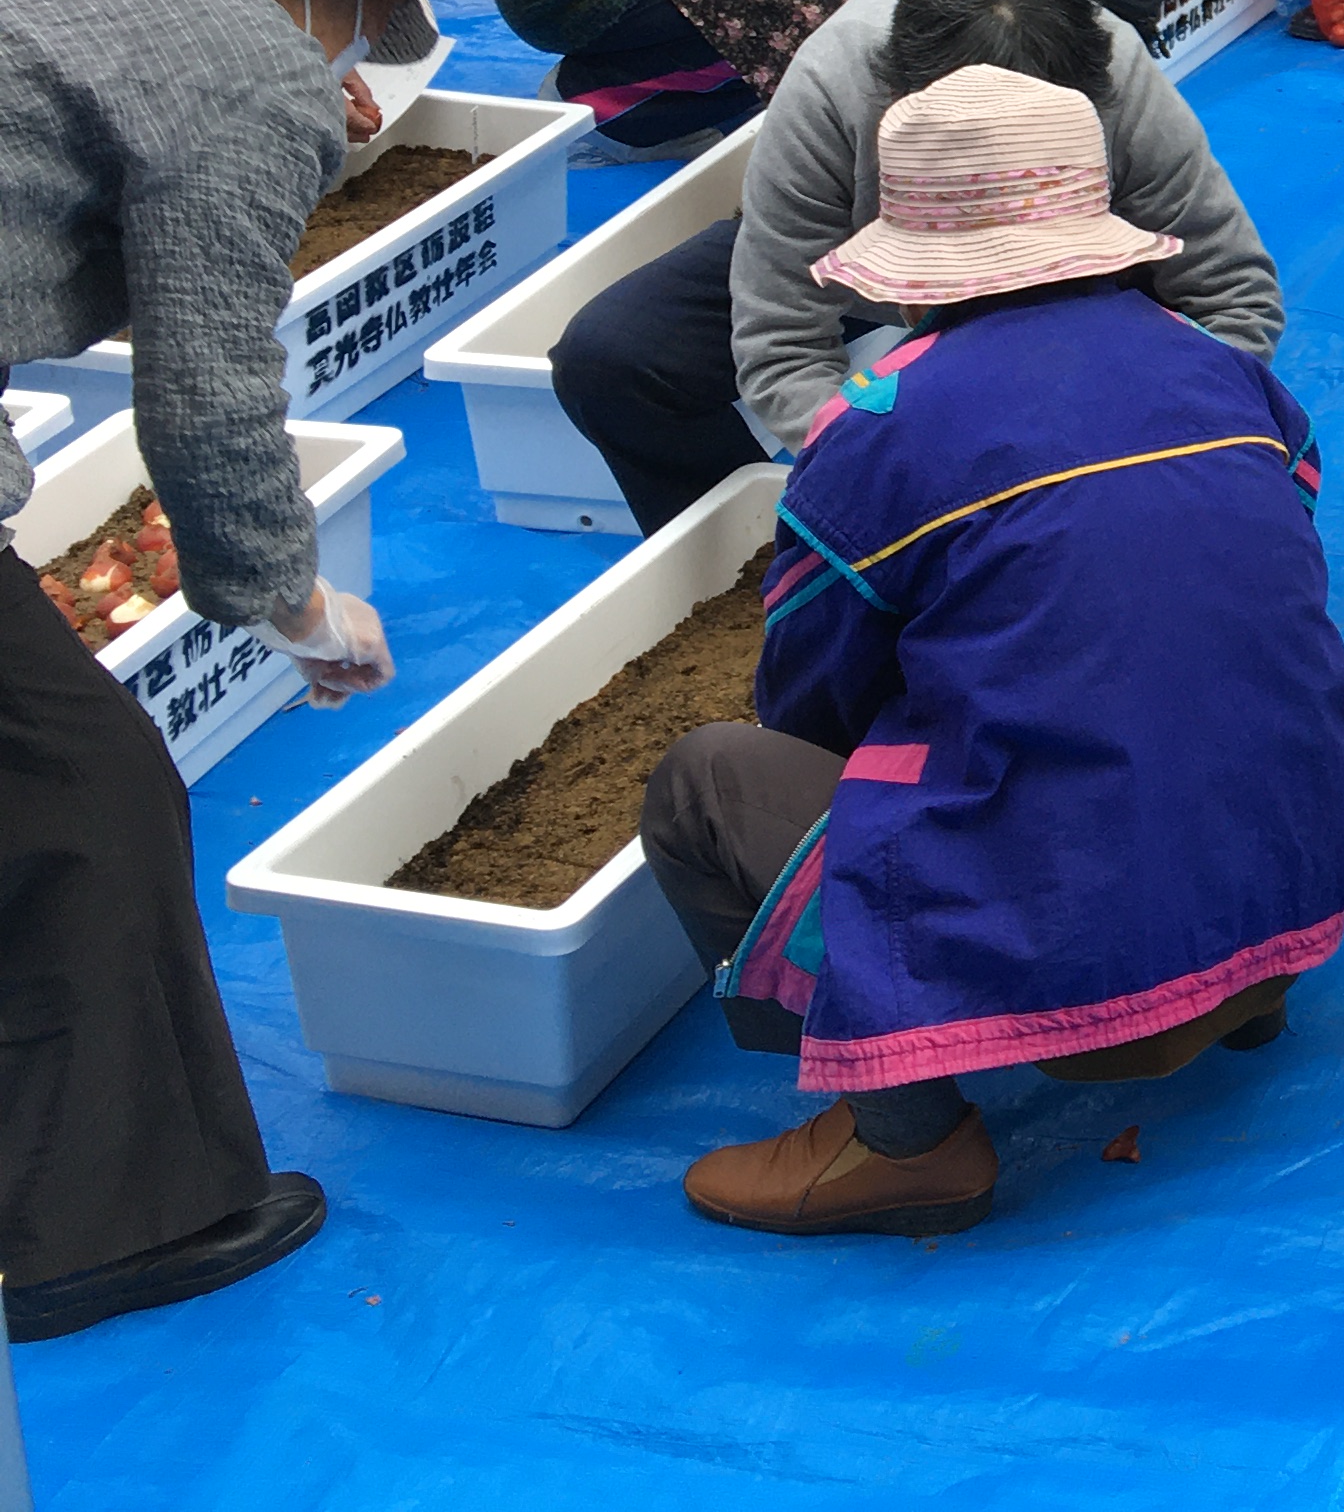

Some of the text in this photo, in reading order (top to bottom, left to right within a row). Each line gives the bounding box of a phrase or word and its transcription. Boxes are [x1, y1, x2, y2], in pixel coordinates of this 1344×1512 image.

[305, 240, 497, 396] 真光寺仏教壮年会
